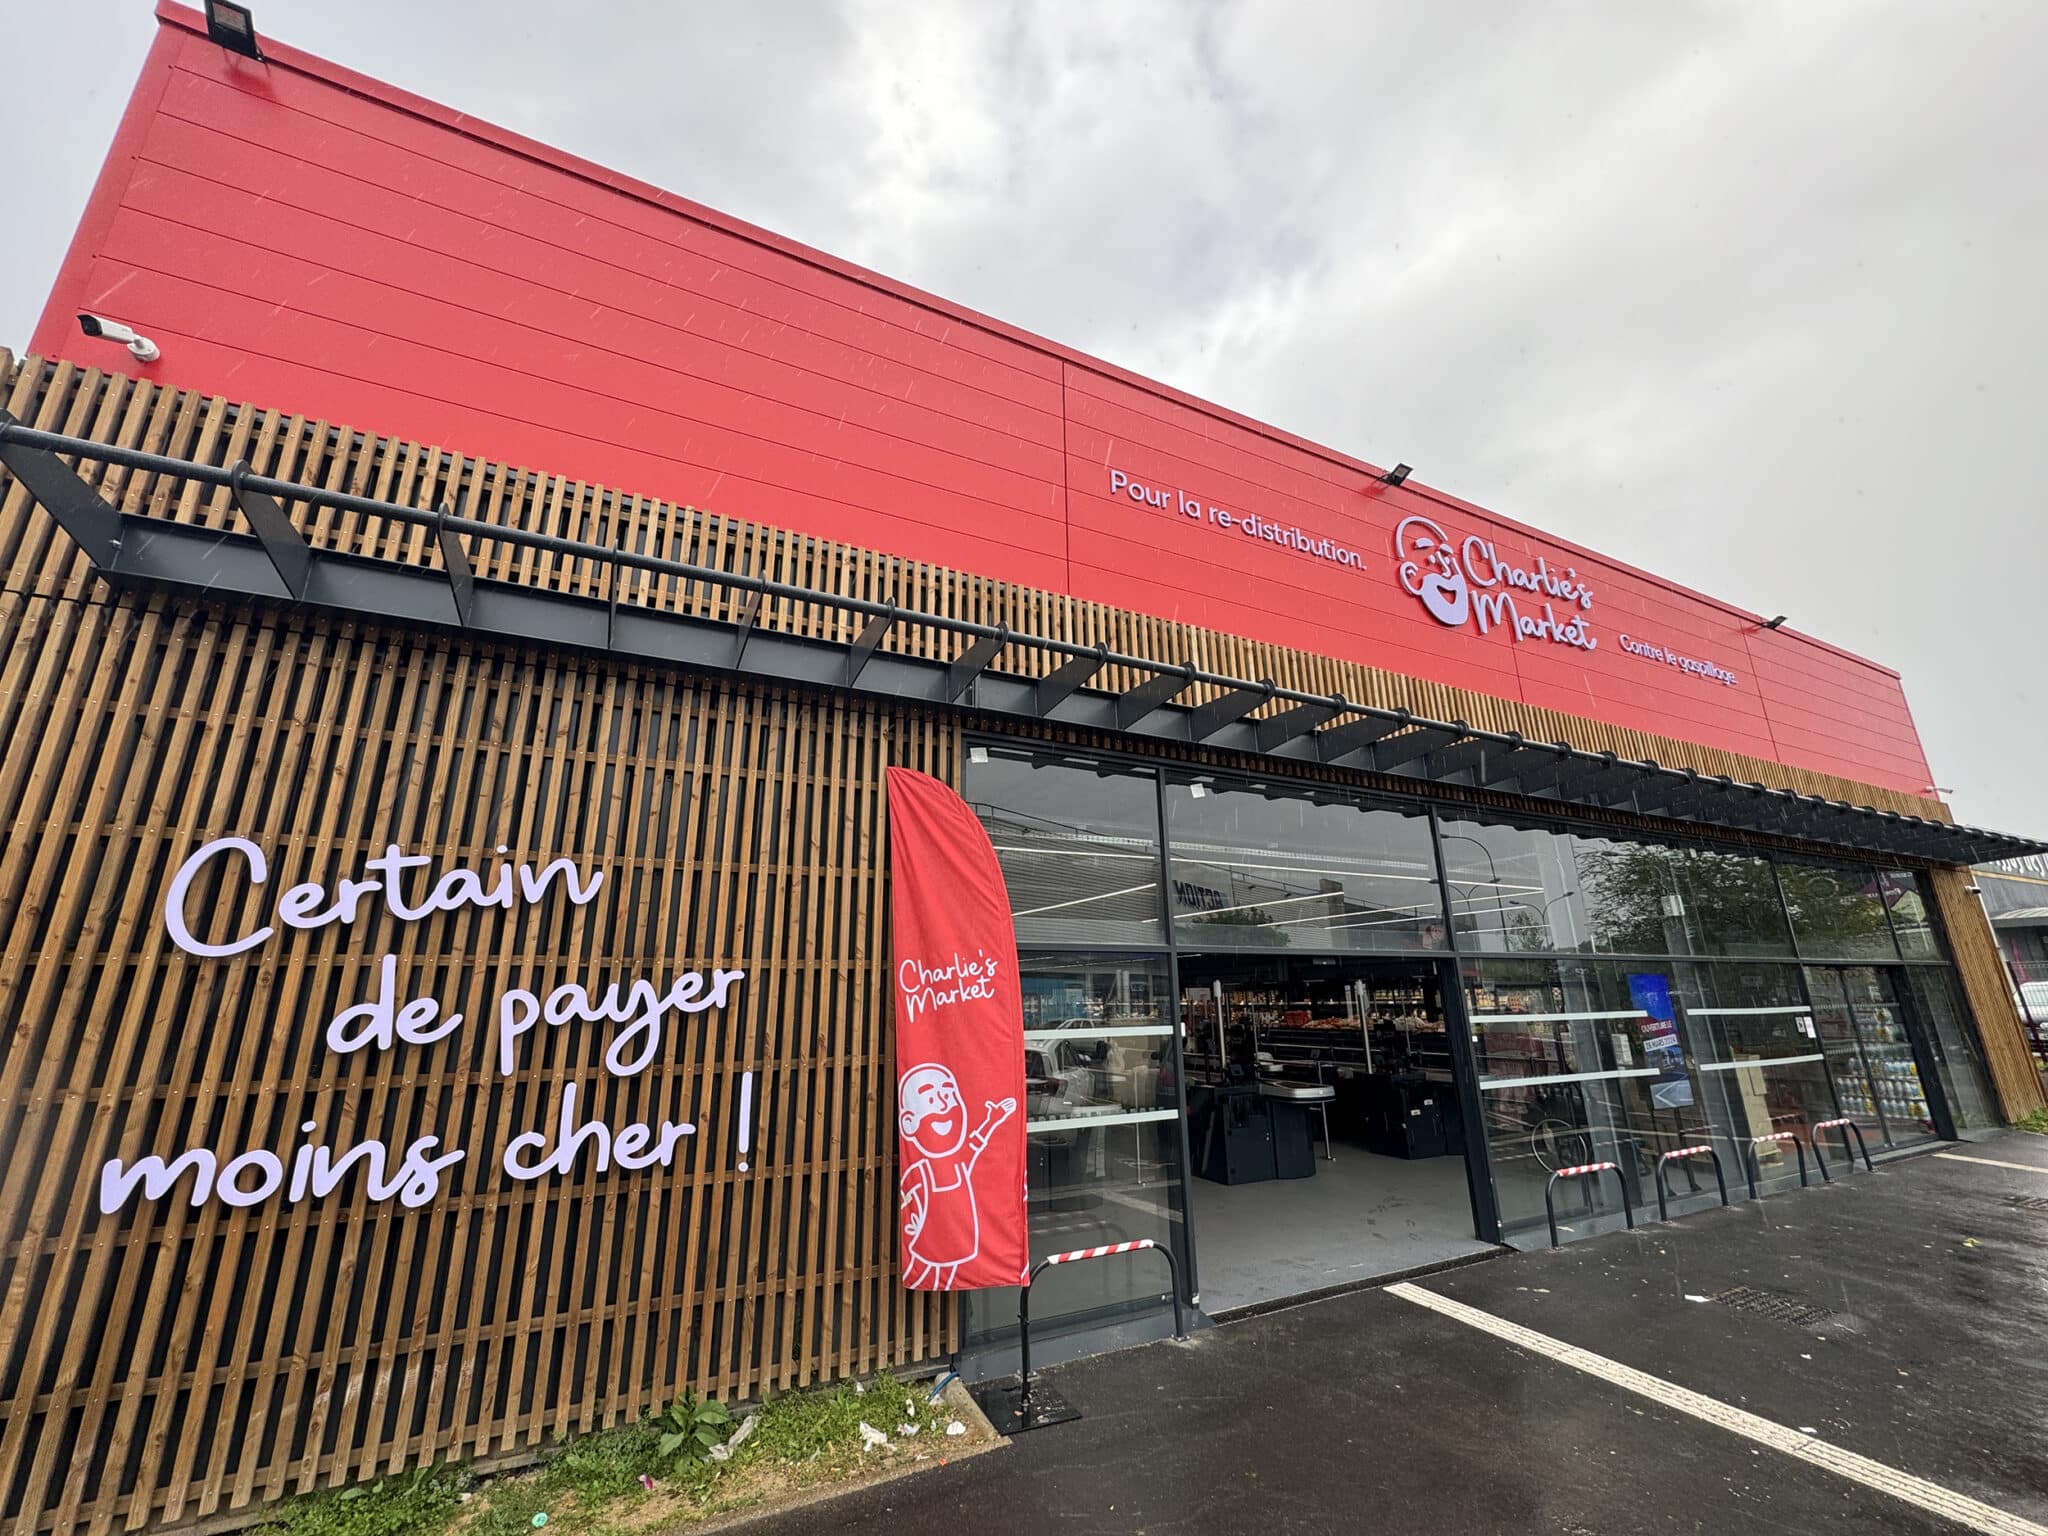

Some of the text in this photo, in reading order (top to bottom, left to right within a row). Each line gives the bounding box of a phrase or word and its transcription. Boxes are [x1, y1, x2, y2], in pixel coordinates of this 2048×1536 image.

[1109, 469, 1367, 570] Pour la re-distribution.
[1462, 535, 1593, 609] Charlie's
[1471, 590, 1597, 650] Market
[1619, 634, 1664, 661] Contre
[1663, 647, 1677, 665] le
[164, 837, 604, 957] Certain
[899, 948, 998, 993] Charlie's
[906, 975, 995, 1024] Market
[326, 954, 745, 1077] de payer
[100, 1121, 464, 1214] moins
[503, 1082, 695, 1180] cher
